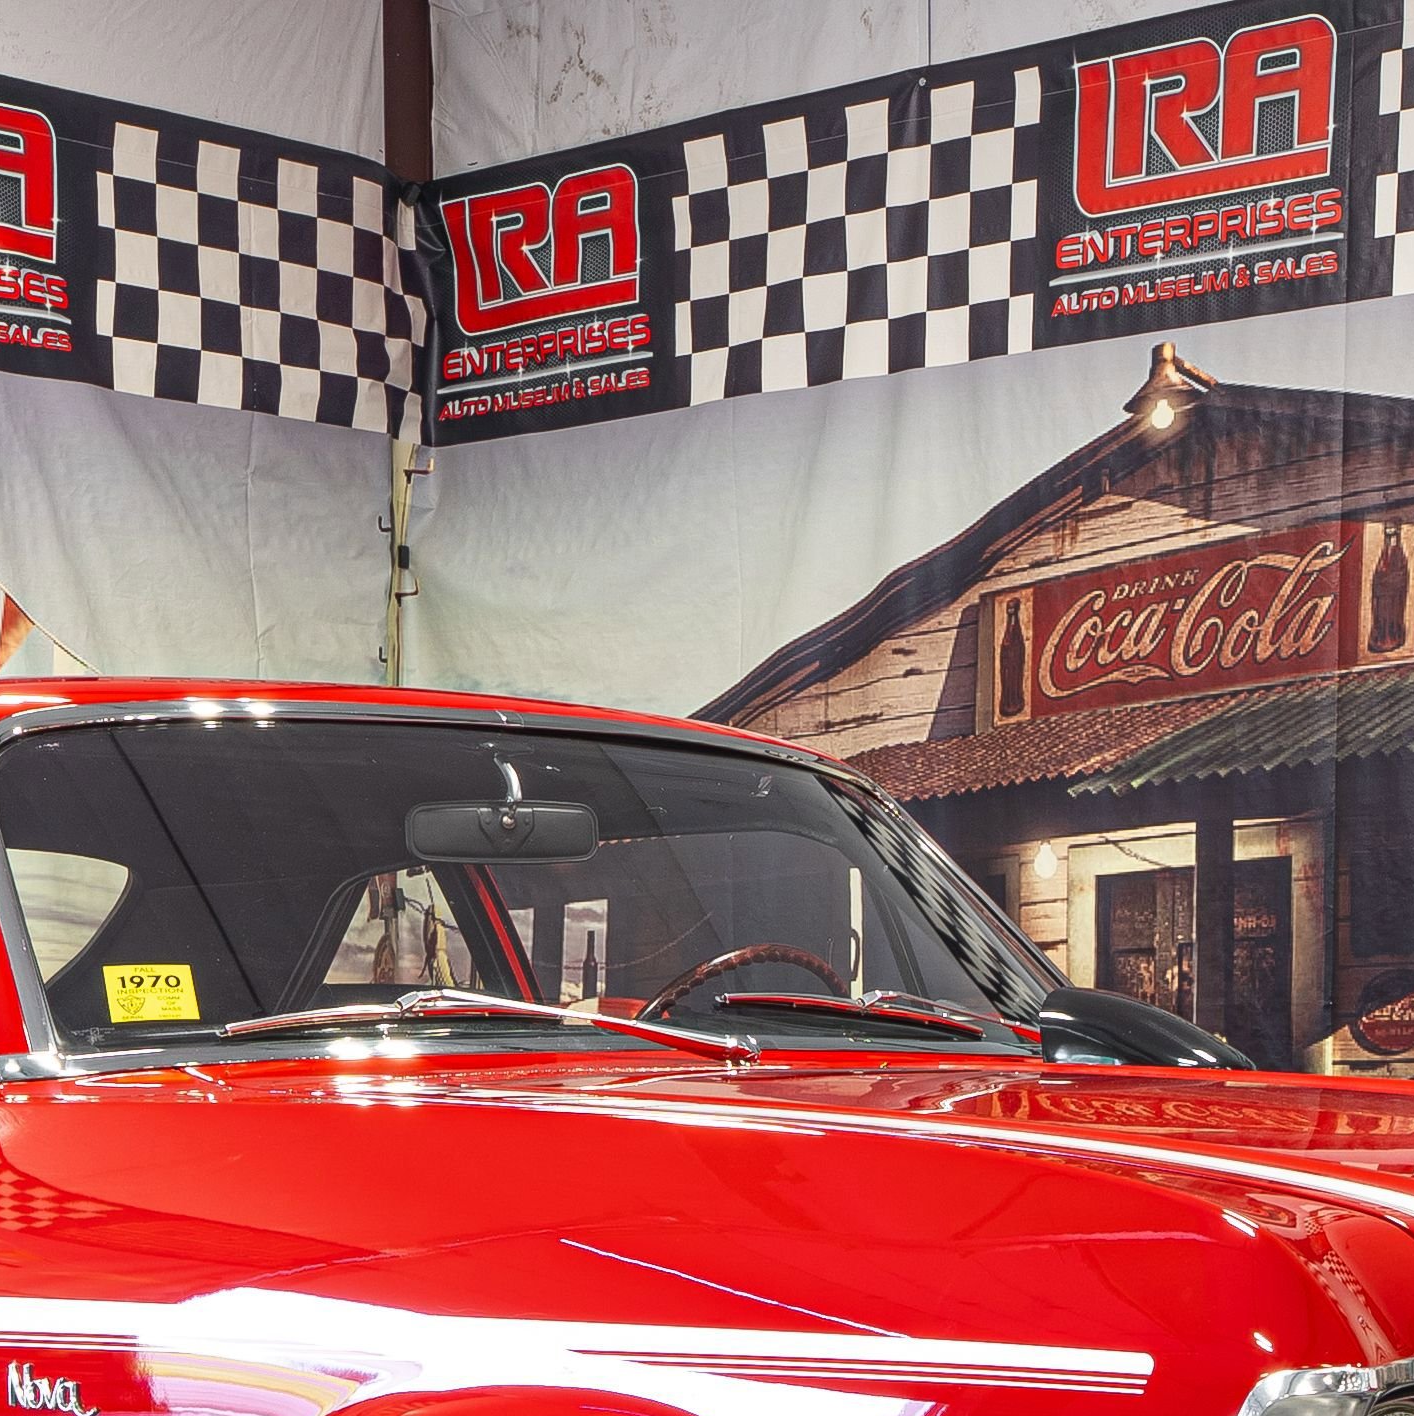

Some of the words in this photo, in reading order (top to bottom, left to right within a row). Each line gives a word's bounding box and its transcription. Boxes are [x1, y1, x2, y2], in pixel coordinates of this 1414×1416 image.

[1055, 188, 1342, 270] ENTERPRISES
[1051, 289, 1118, 317] AUTO
[1122, 271, 1229, 306] MUSEUM
[1234, 264, 1250, 288] &
[1254, 250, 1338, 285] SALES
[443, 314, 651, 380] ENTERPRISES
[439, 391, 491, 421] AUTO
[494, 377, 571, 412] MUSEUM
[573, 377, 586, 397] &
[587, 368, 650, 396] SALES
[1111, 568, 1200, 602] DRINK
[117, 975, 181, 989] 1970
